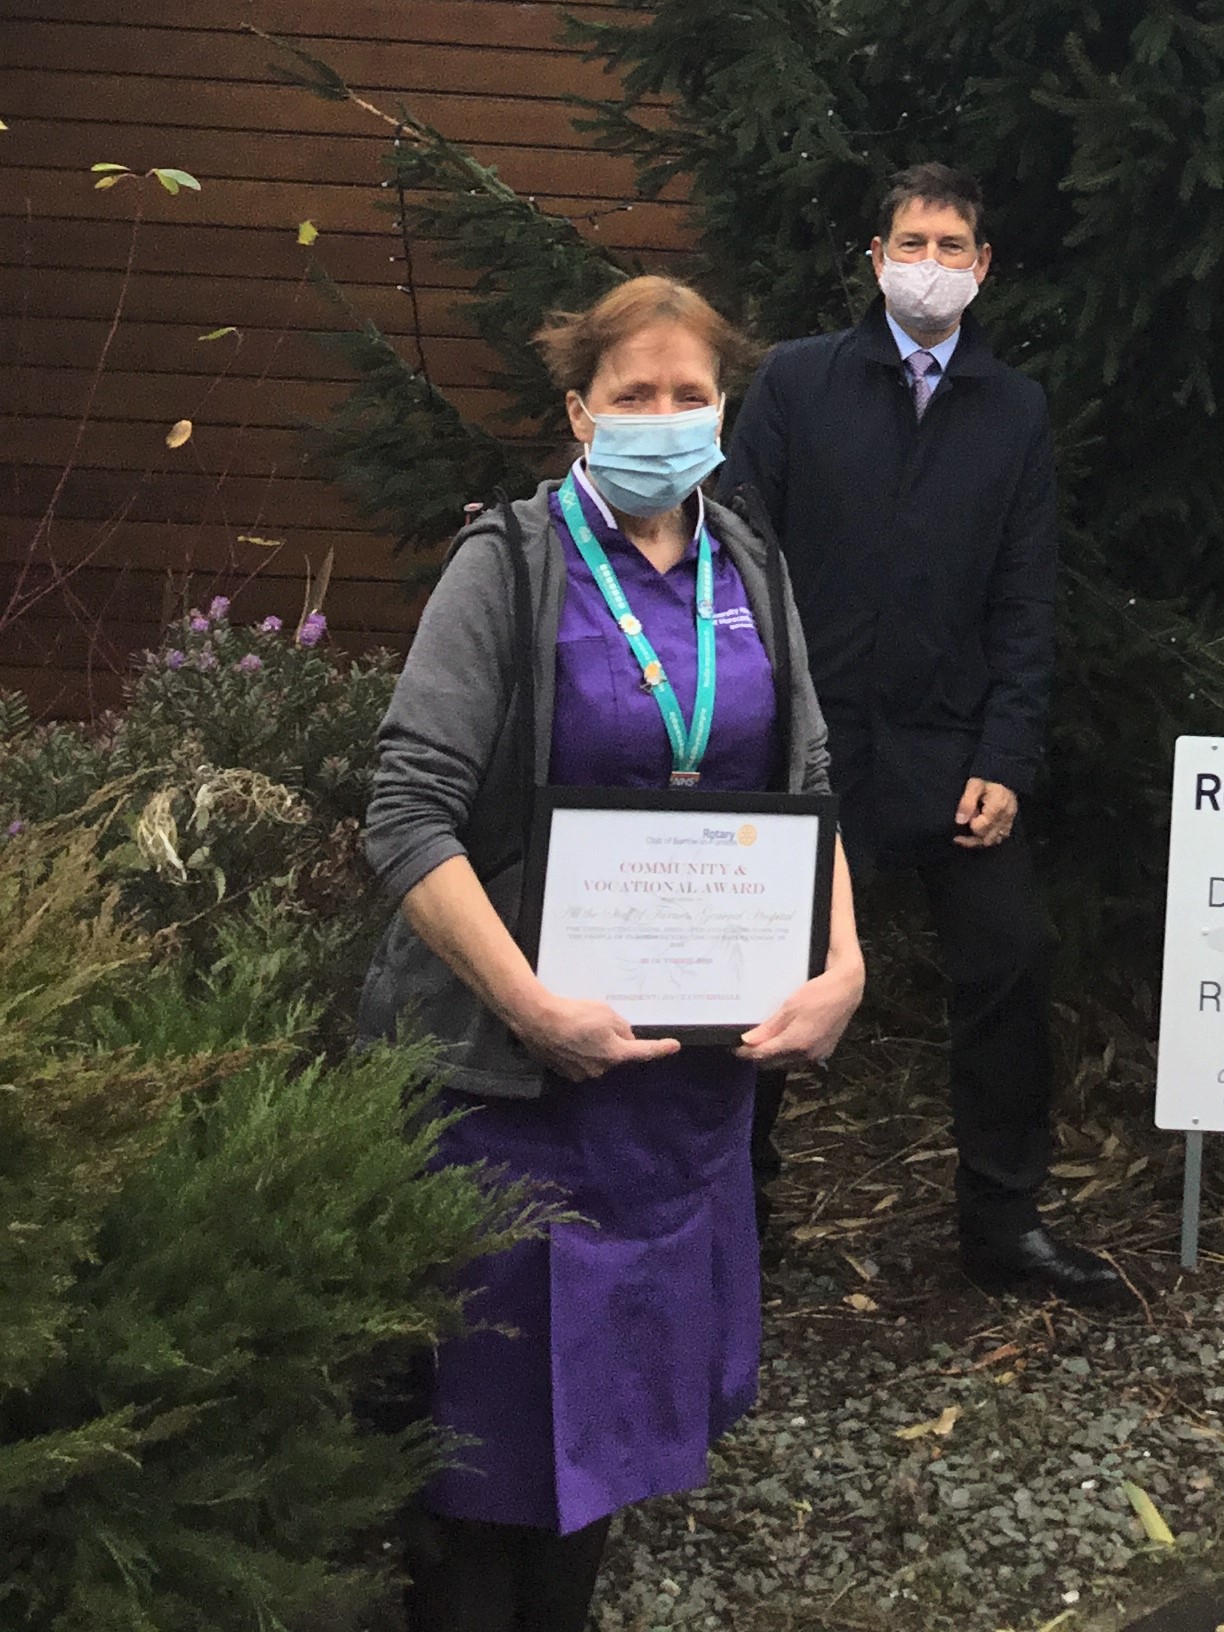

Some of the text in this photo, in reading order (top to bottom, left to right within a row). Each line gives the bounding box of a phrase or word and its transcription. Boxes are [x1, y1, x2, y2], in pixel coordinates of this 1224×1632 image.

[703, 828, 736, 842] Rotary
[619, 861, 748, 876] COMMUNITY &
[583, 879, 766, 896] VOCATIONAL AWARD
